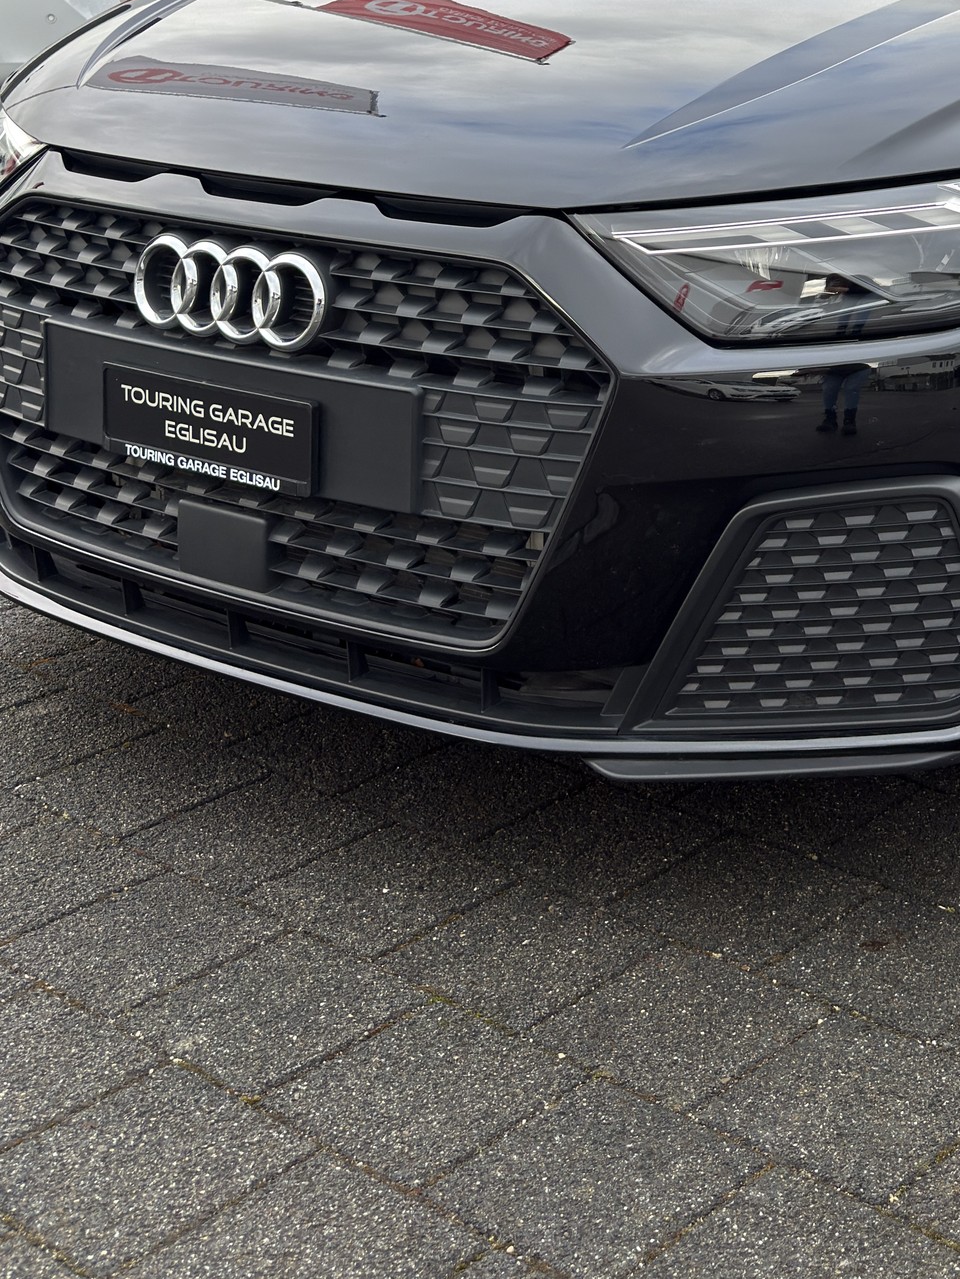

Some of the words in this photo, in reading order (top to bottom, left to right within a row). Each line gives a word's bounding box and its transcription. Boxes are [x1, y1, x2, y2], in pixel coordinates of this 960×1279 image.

[121, 384, 205, 418] TOURING
[209, 403, 294, 437] GARAGE
[165, 420, 247, 453] EGLISAU
[125, 444, 175, 466] TOURING
[177, 457, 227, 478] GARAGE
[229, 469, 281, 491] EGLISAU
